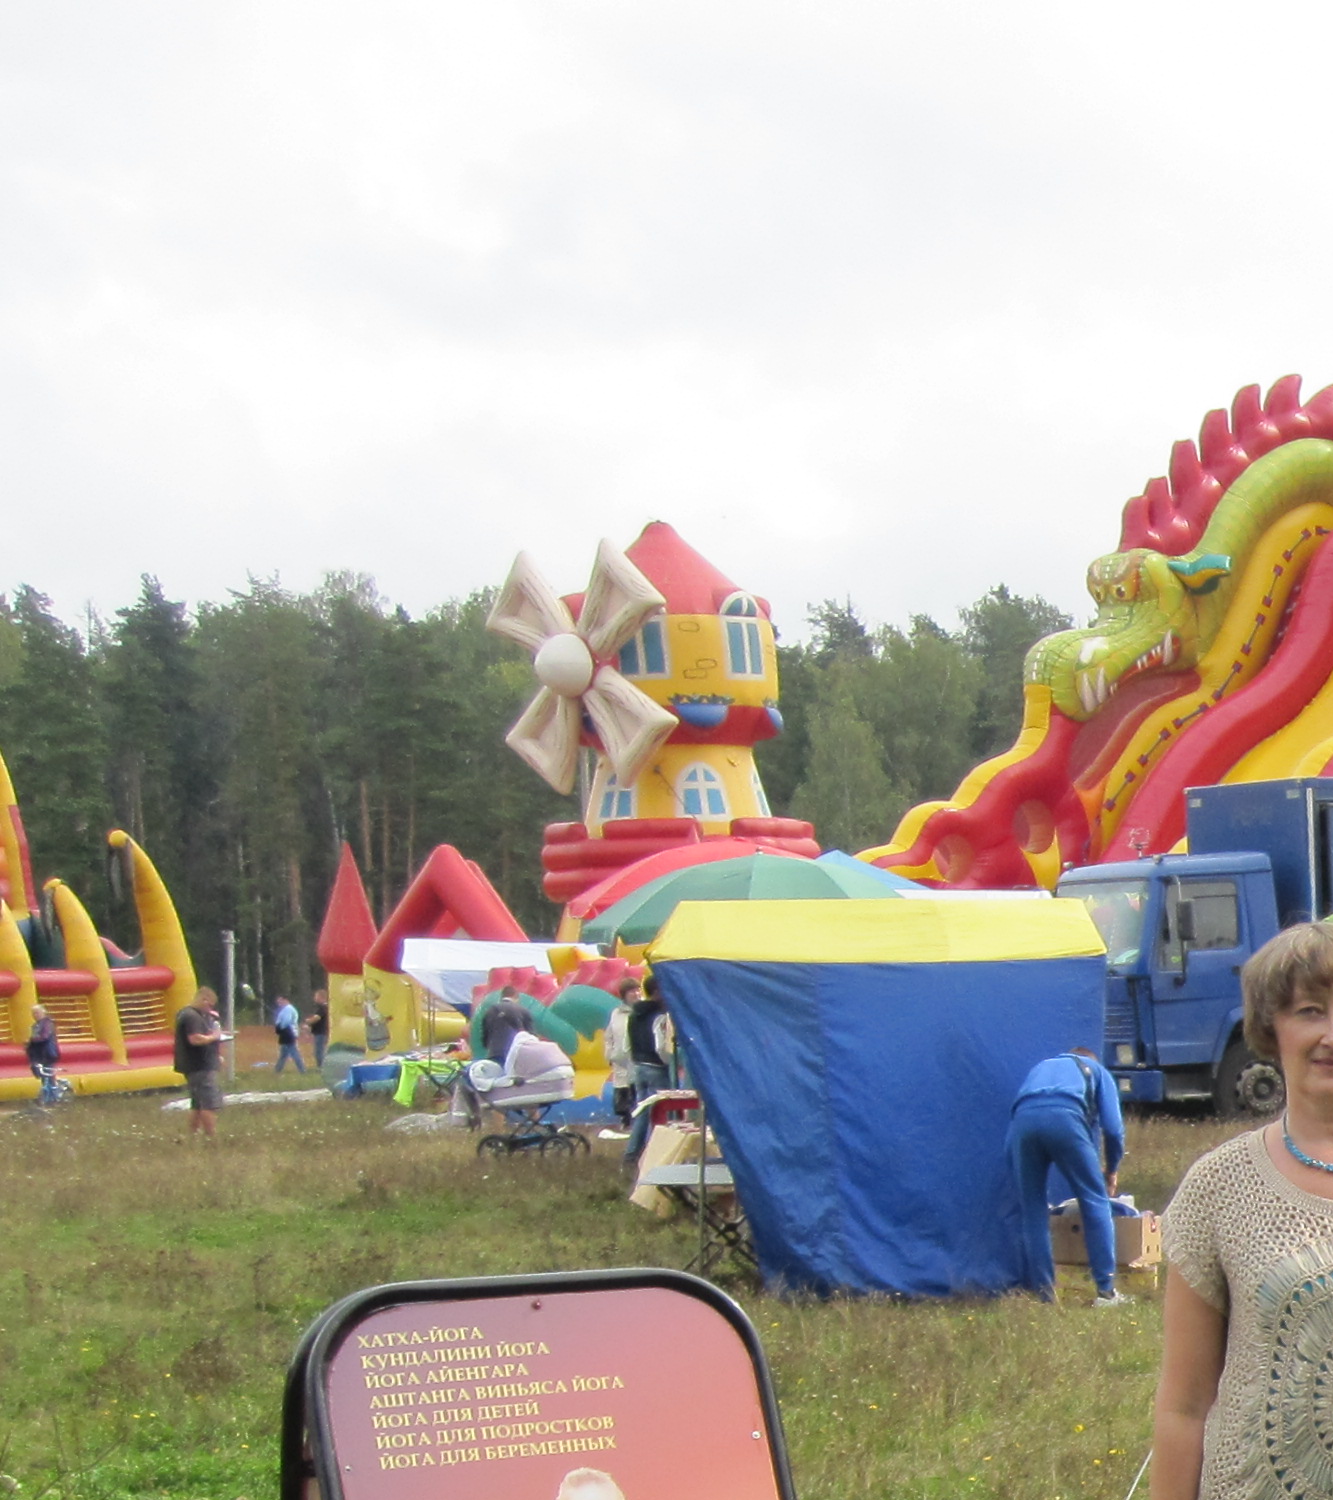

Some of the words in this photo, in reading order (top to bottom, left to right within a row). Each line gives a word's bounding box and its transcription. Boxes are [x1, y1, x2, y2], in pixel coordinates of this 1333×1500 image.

[357, 1326, 484, 1349] ХАТХА-ЙОГА
[360, 1345, 492, 1371] КУНДАЛИНИ
[496, 1341, 550, 1358] ЙОГА
[365, 1371, 421, 1389] ЙОГА
[426, 1362, 529, 1384] АЙЕНГАРА
[369, 1388, 471, 1409] АШТАНГА
[474, 1380, 568, 1400] ВИНЬЯСА
[571, 1375, 625, 1392] ЙОГА
[372, 1412, 428, 1429] ЙОГА
[432, 1407, 473, 1426] ДЛЯ
[477, 1399, 540, 1422] ДЕТЕЙ
[376, 1432, 432, 1450] ЙОГА
[436, 1427, 477, 1446] ДЛЯ
[480, 1416, 615, 1440] ПОДРОСТКОВ
[380, 1452, 436, 1470] ЙОГА
[440, 1447, 481, 1466] ДЛЯ
[484, 1435, 617, 1460] БЕРЕМЕННЫХ
